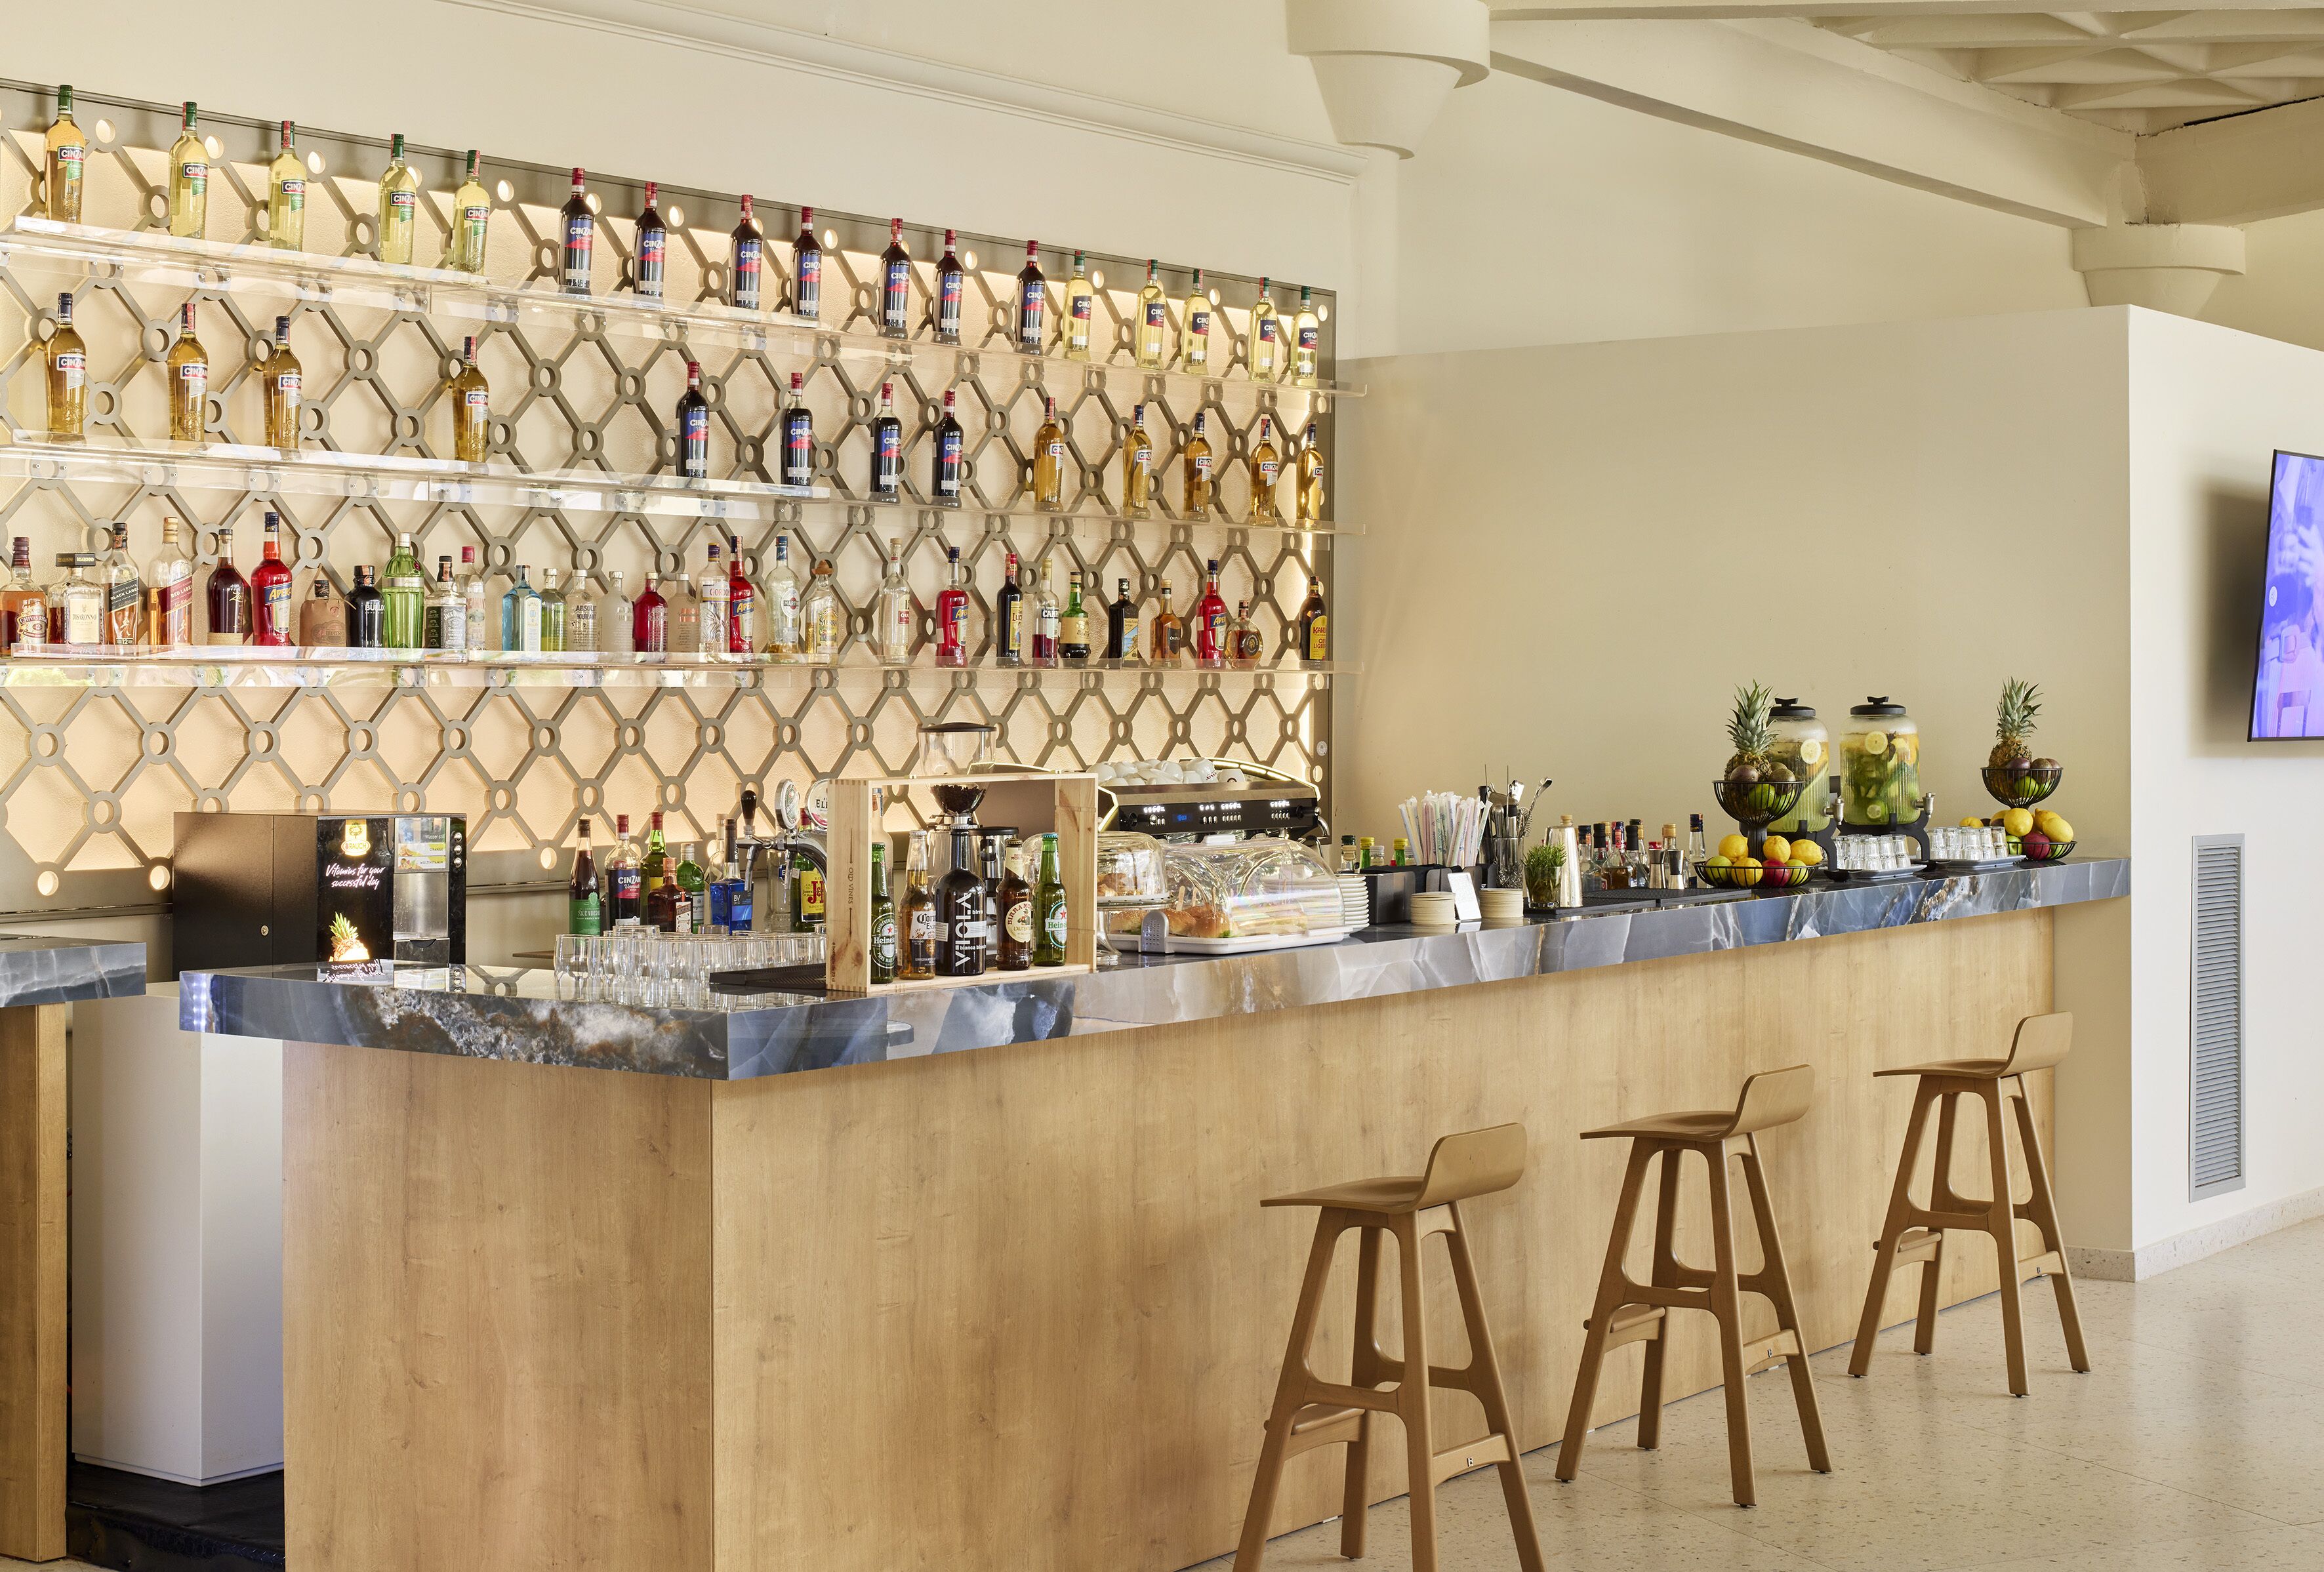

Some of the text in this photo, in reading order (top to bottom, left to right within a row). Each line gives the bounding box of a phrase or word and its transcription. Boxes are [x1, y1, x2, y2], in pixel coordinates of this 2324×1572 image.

[325, 863, 386, 879] Vitamins for your
[331, 875, 380, 891] successful day
[1008, 903, 1023, 925] BIRRA
